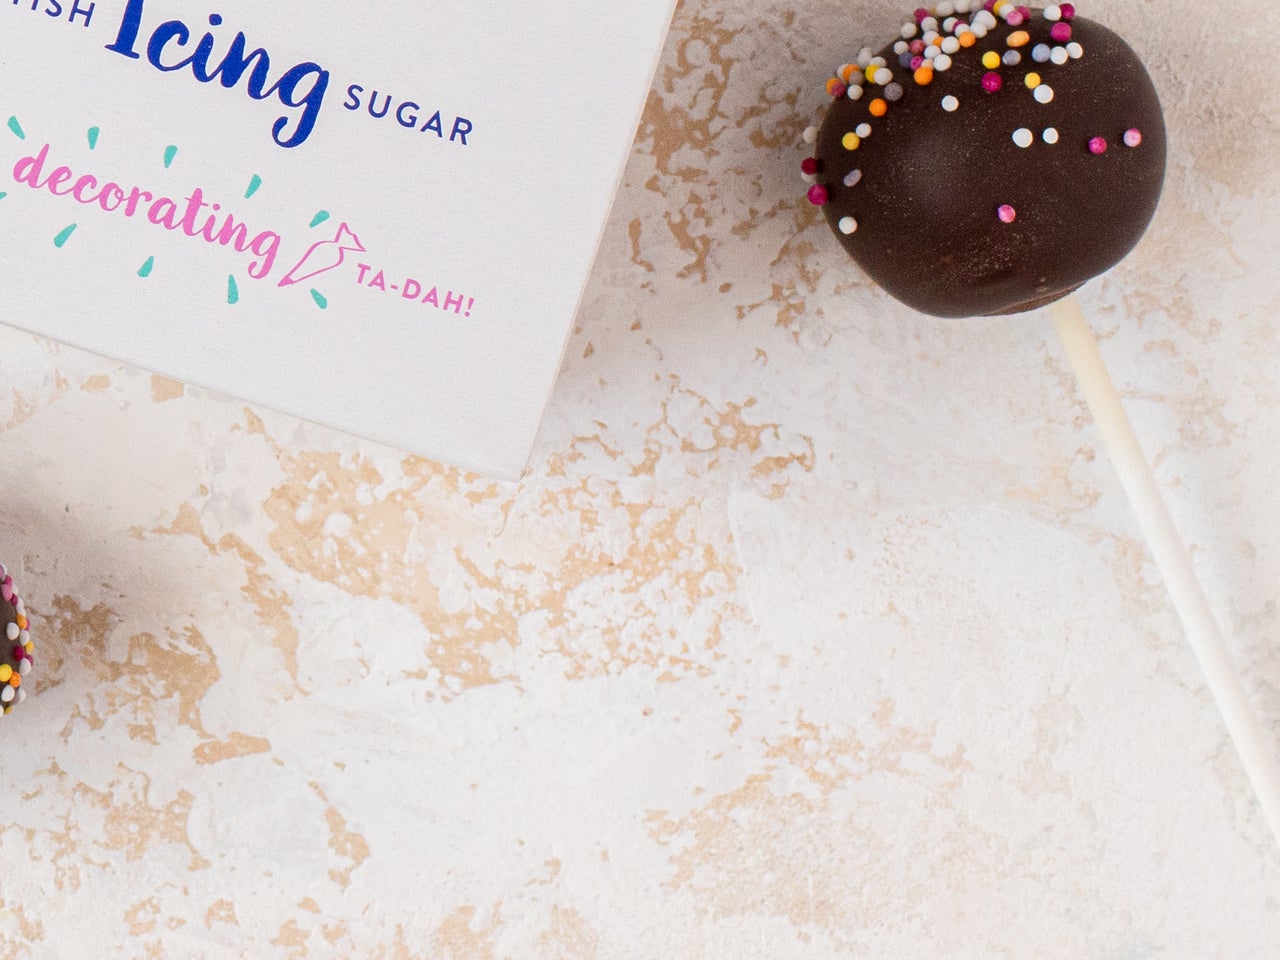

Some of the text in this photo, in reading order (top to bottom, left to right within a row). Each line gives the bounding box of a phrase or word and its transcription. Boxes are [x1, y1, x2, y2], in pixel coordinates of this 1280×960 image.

[342, 84, 474, 146] SUGAR
[12, 143, 281, 280] decorating
[356, 262, 476, 318] TA-DAH!
